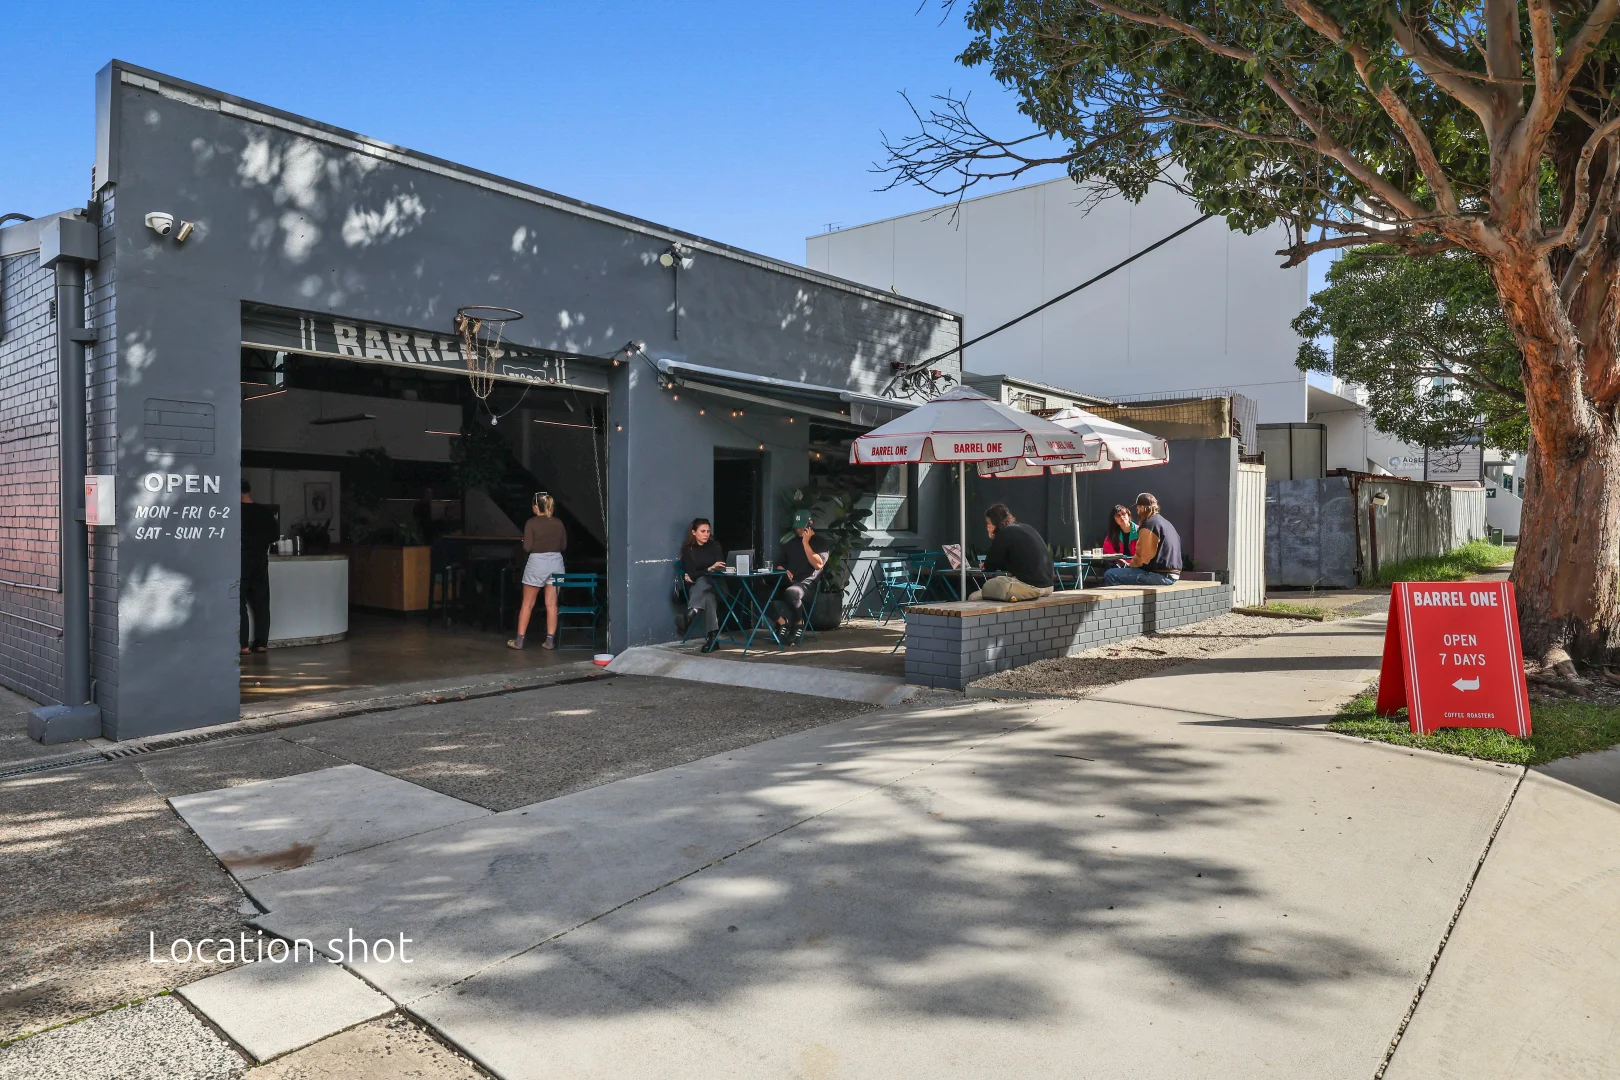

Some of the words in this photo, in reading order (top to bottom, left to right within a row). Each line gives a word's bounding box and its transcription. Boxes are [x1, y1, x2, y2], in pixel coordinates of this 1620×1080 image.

[871, 446, 894, 456] BARREL
[895, 446, 908, 455] ONE
[954, 443, 984, 453] BARREL
[986, 443, 1003, 453] ONE
[144, 473, 220, 494] OPEN
[135, 506, 170, 519] MON
[181, 506, 203, 519] FRI
[208, 506, 231, 519] 6-2
[135, 527, 162, 540] SAT
[174, 527, 203, 539] SUN
[208, 526, 225, 539] 7-1
[1413, 592, 1467, 606] BARREL
[1470, 592, 1498, 606] ONE
[1443, 634, 1477, 646] OPEN
[1439, 653, 1447, 666] 7
[1453, 653, 1486, 666] DAYS
